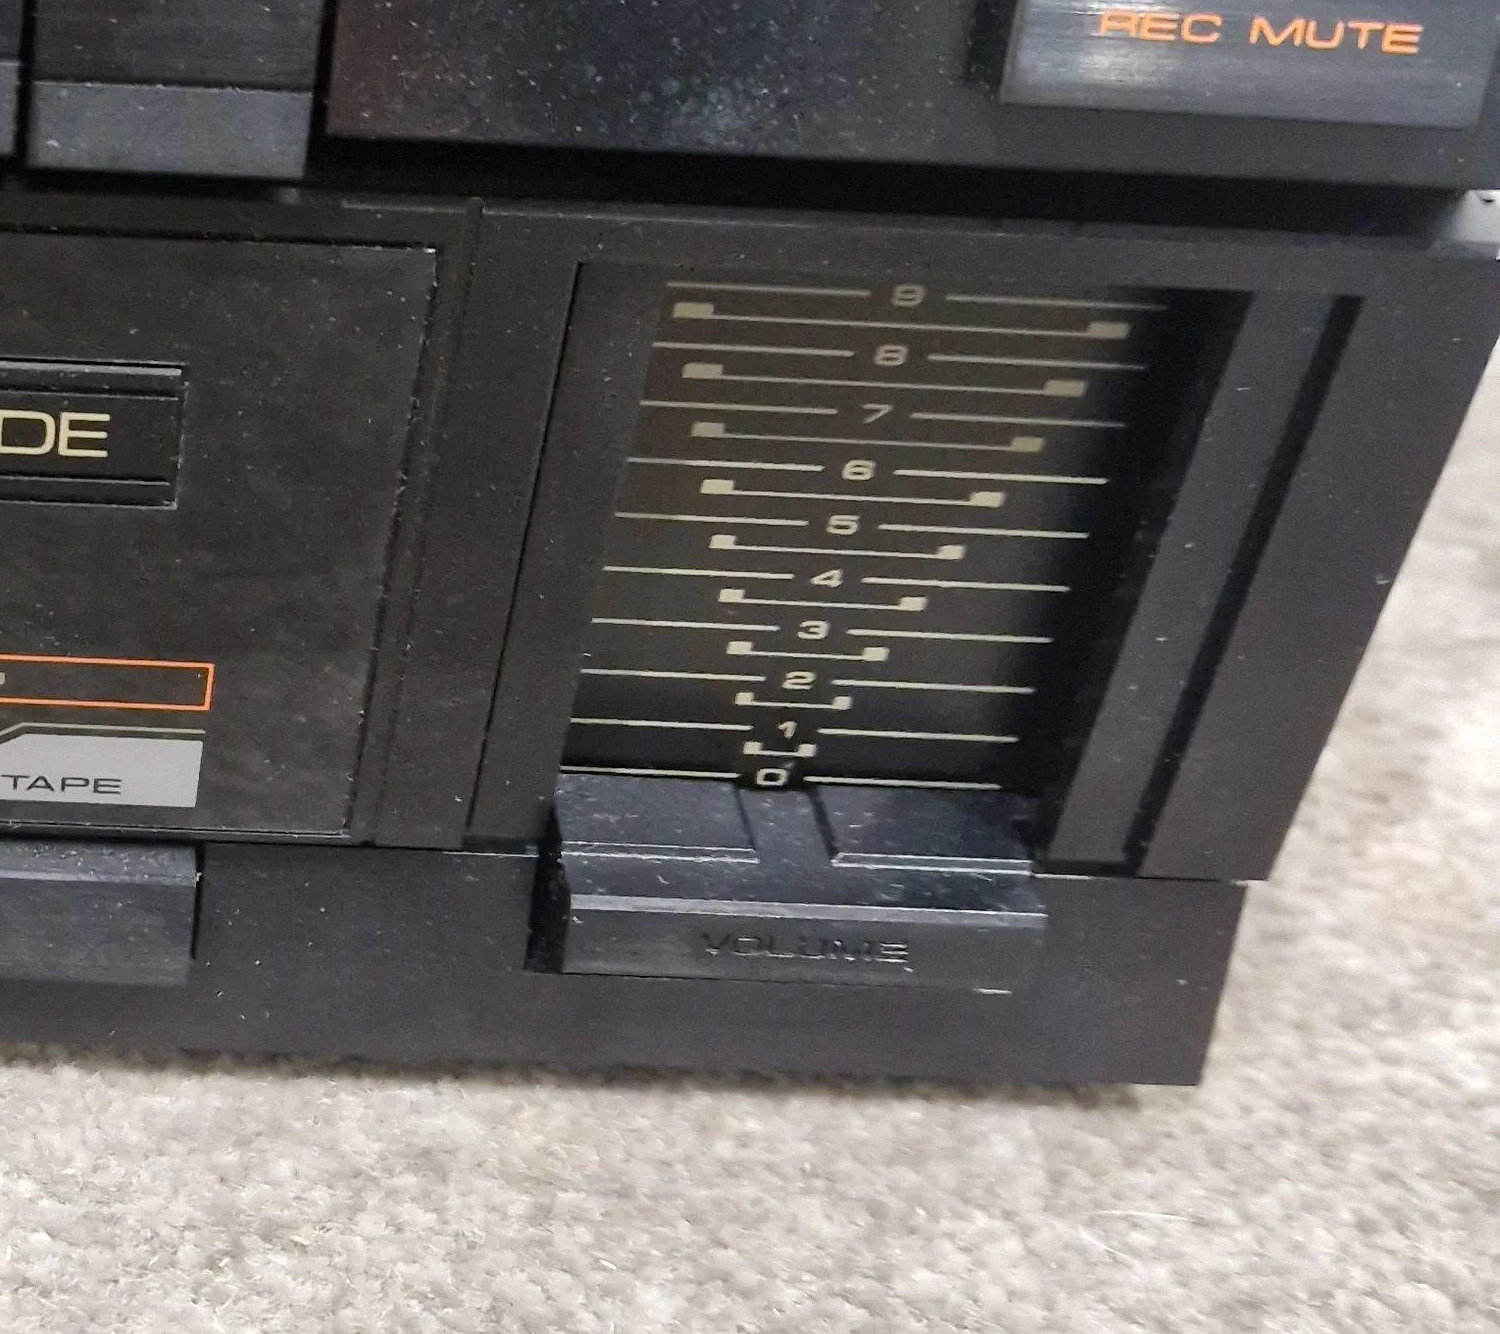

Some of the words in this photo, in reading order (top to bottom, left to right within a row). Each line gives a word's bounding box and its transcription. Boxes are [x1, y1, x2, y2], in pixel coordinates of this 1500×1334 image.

[1098, 10, 1222, 44] REC
[1249, 15, 1423, 55] MUTE
[893, 284, 926, 307] 9
[874, 345, 908, 366] 8
[862, 403, 893, 423] 7
[842, 460, 876, 481] 6
[826, 515, 860, 535] 5
[810, 570, 843, 588] 4
[796, 620, 830, 641] 3
[781, 670, 817, 691] 2
[777, 720, 798, 740] 1
[0, 774, 123, 796] TAPE
[756, 767, 790, 787] 0
[701, 933, 908, 963] VOLUME
